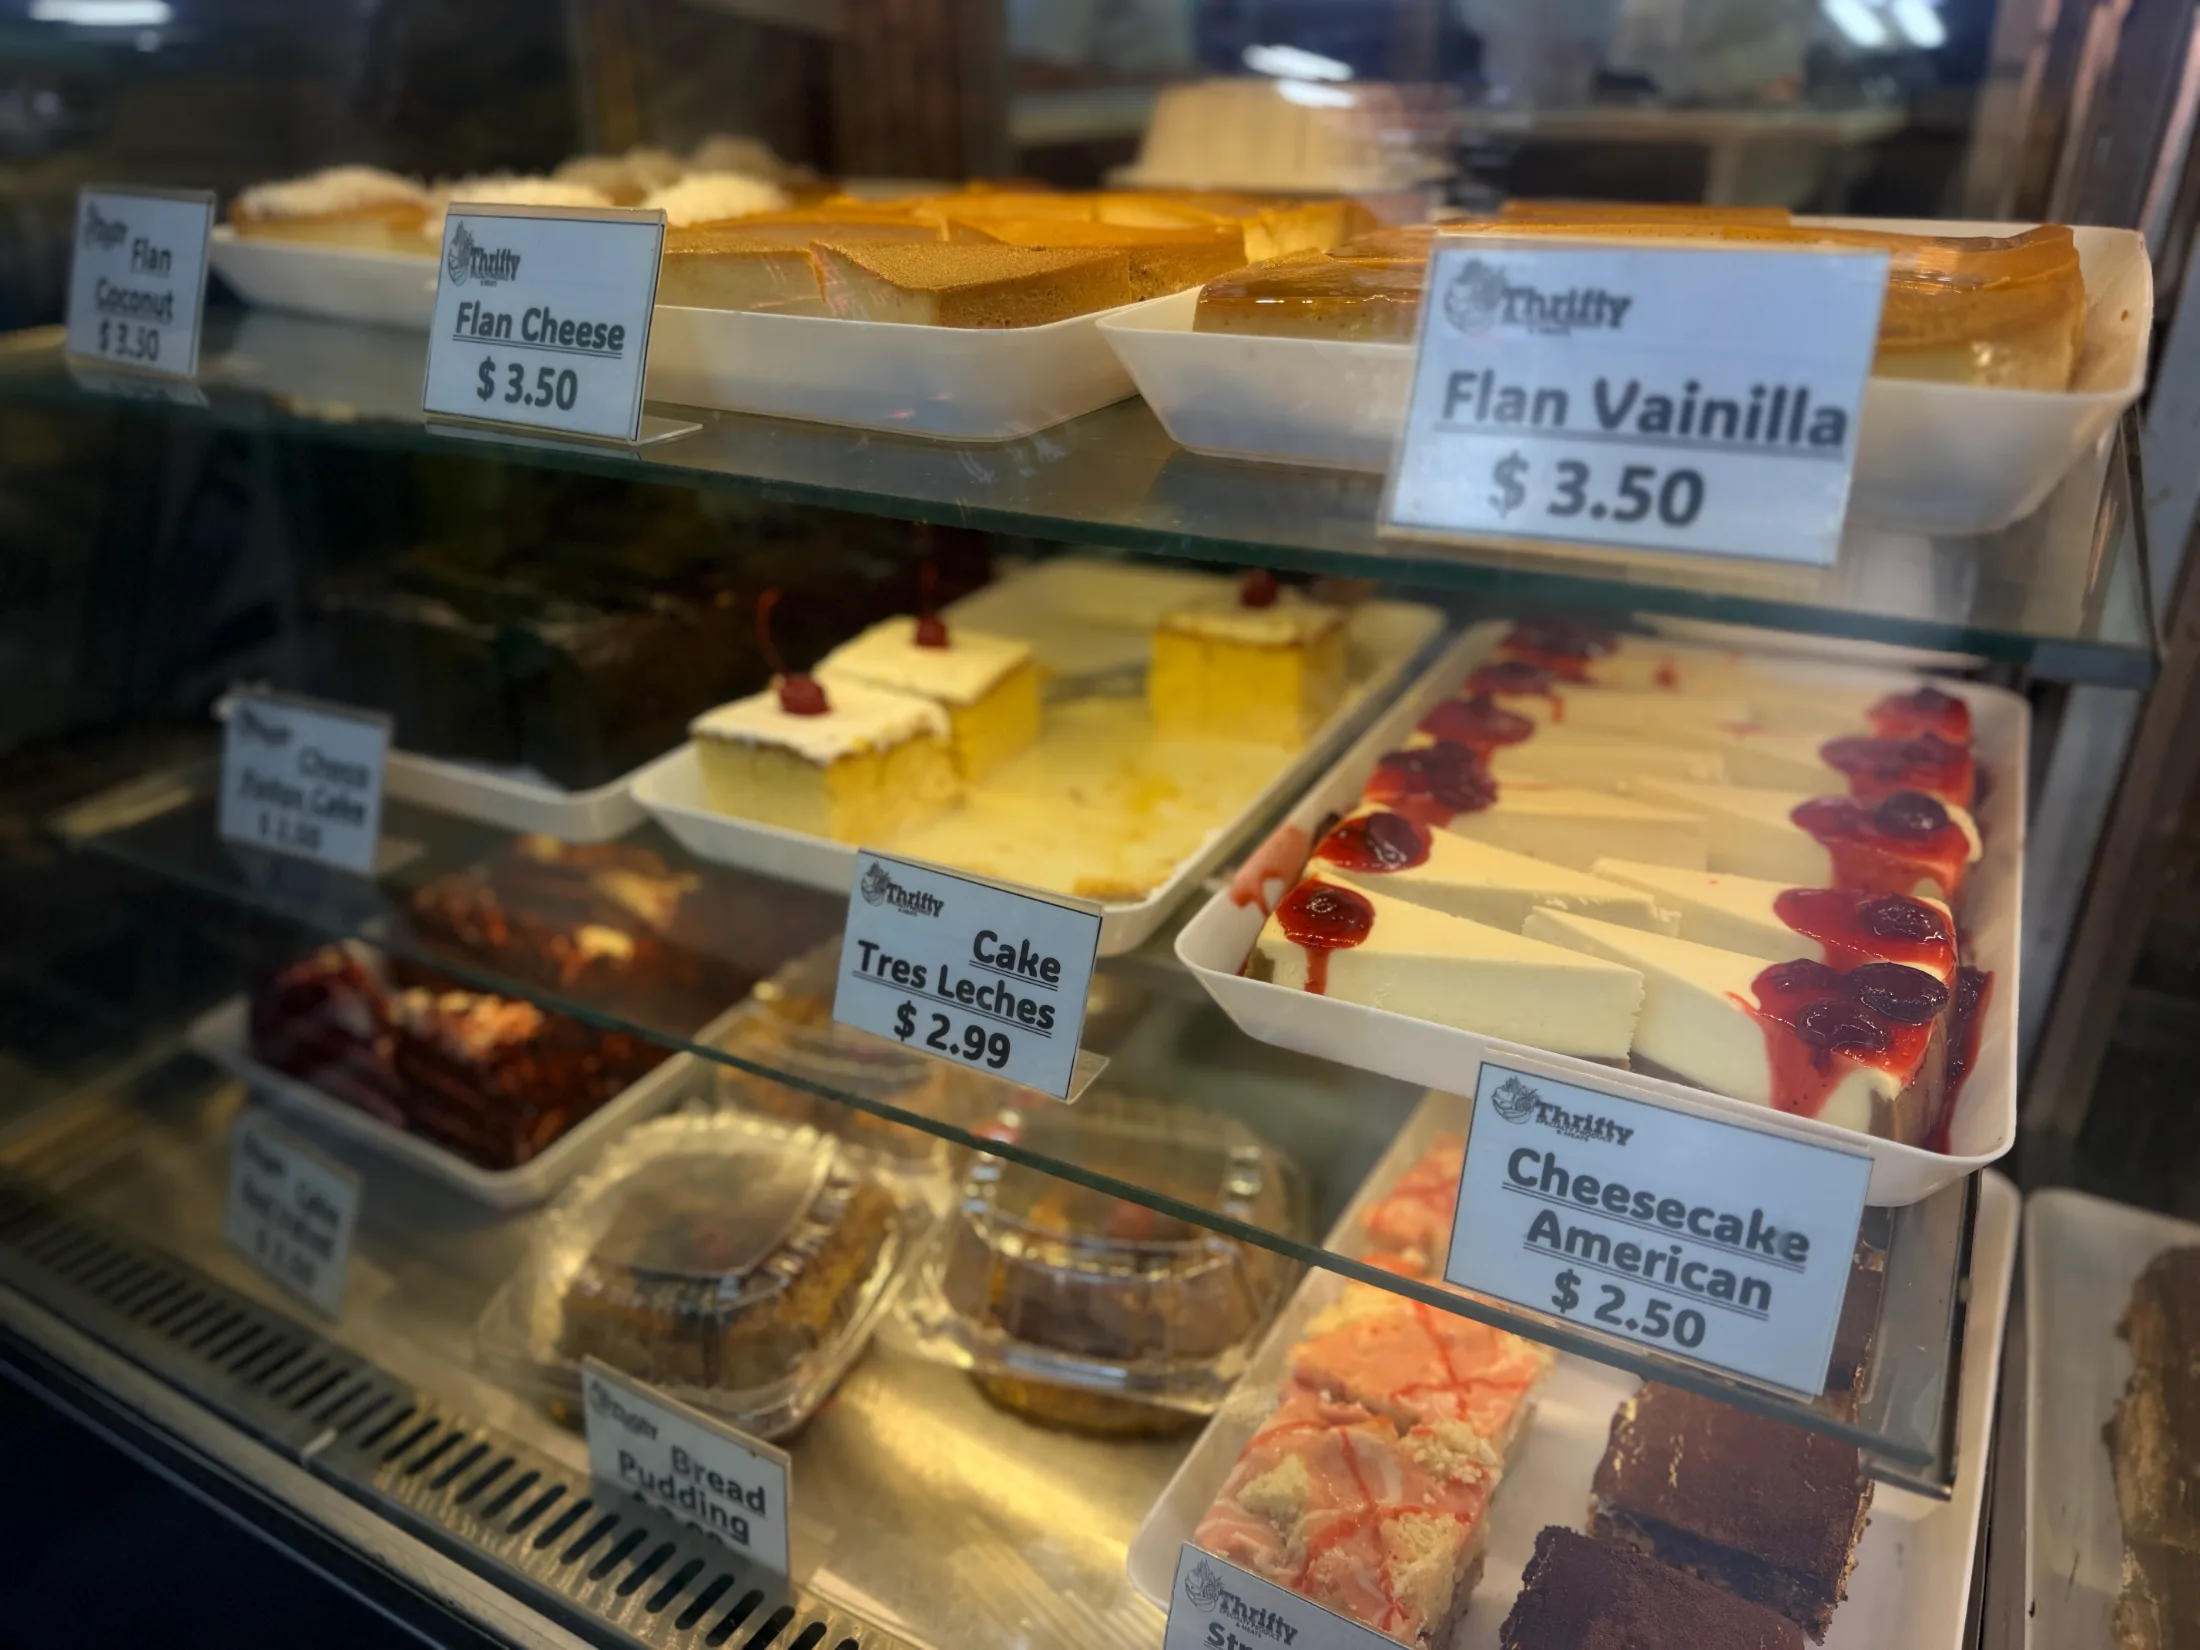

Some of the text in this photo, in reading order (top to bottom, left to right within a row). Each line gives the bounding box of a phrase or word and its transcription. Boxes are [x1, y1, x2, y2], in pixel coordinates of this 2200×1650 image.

[131, 237, 172, 273] Flan
[470, 246, 521, 282] Thrifty
[455, 299, 626, 351] Flan Cheese
[1501, 285, 1633, 329] Thrifty
[476, 355, 579, 411] $ 3.50
[1440, 368, 1848, 449] Flan Vainilla
[1488, 449, 1706, 528] $ 3.50
[886, 882, 945, 918] Thrifty
[857, 939, 1056, 1030] Tres Leches
[972, 929, 1062, 984] Cake
[893, 1000, 1011, 1069] $ 2.99
[1535, 1100, 1635, 1147] Thrifty
[1507, 1147, 1811, 1264] Cheesecake
[1526, 1208, 1773, 1312] American
[1551, 1268, 1707, 1349] $ 2.50
[618, 1449, 750, 1546] Pudding
[671, 1444, 766, 1515] Bread
[1218, 1588, 1299, 1647] Thrifty
